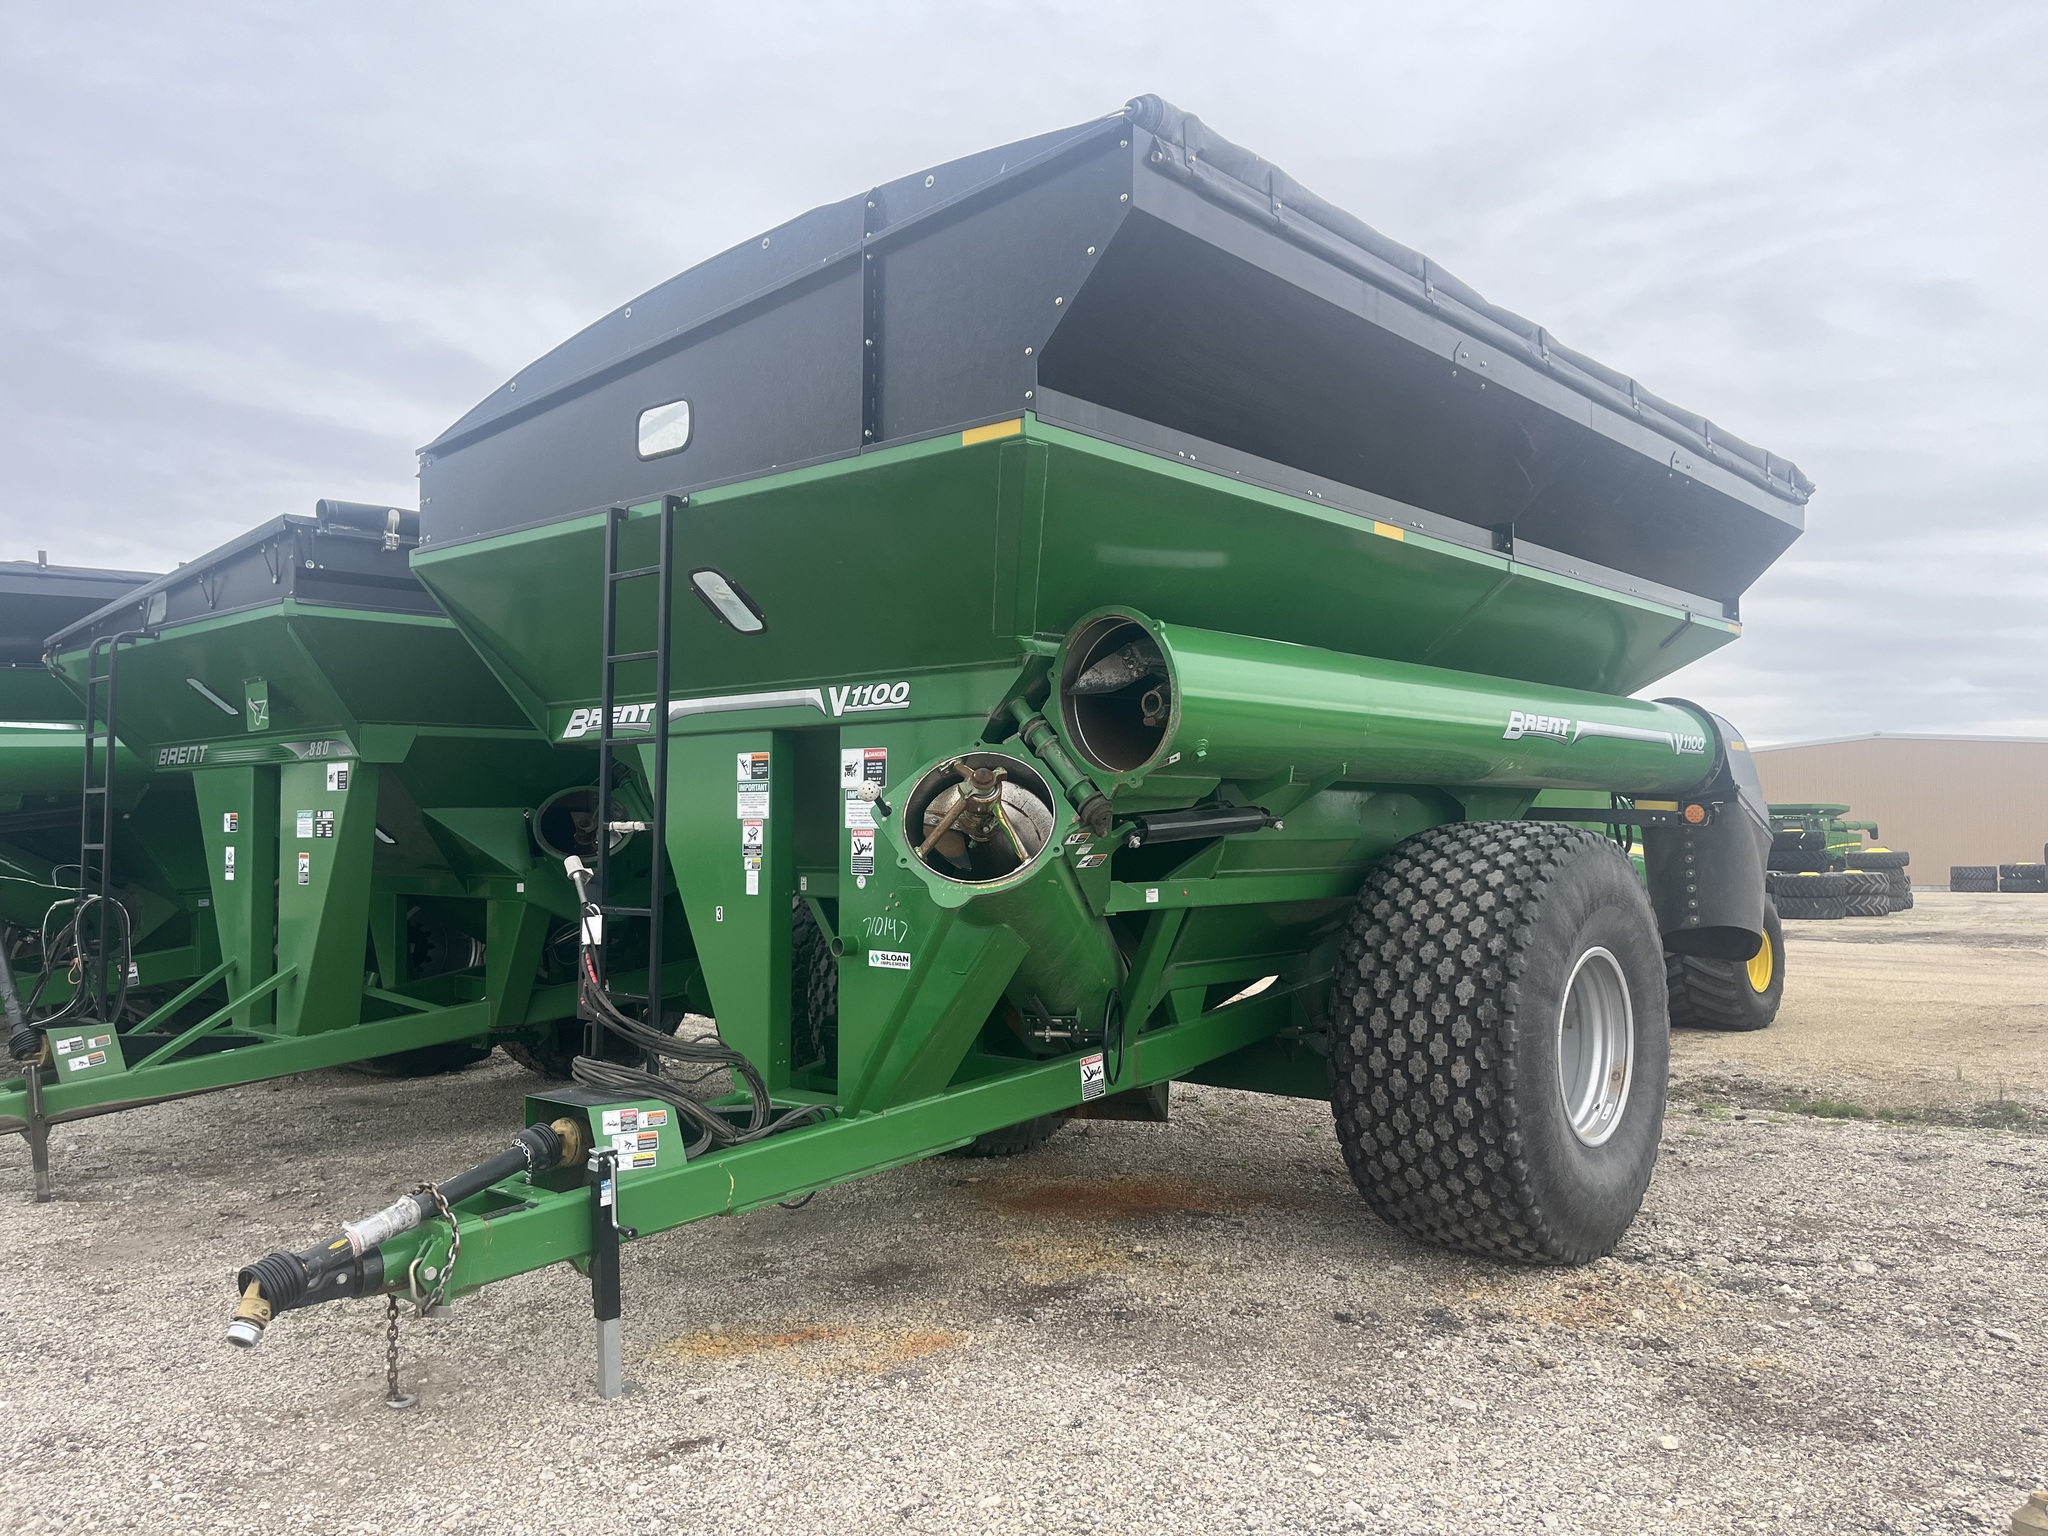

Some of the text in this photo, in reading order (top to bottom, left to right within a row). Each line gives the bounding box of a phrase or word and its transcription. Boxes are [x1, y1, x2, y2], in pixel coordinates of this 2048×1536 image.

[563, 681, 911, 738] BRENT V1100
[1502, 710, 1705, 756] BRENT V1100
[158, 740, 330, 766] BRENT 880
[868, 750, 886, 758] DANGER
[739, 783, 768, 792] IMPORTANT
[717, 907, 722, 921] 3
[862, 916, 909, 944] 710147
[880, 953, 909, 963] SLOAN
[880, 960, 909, 968] IMPLEMENT
